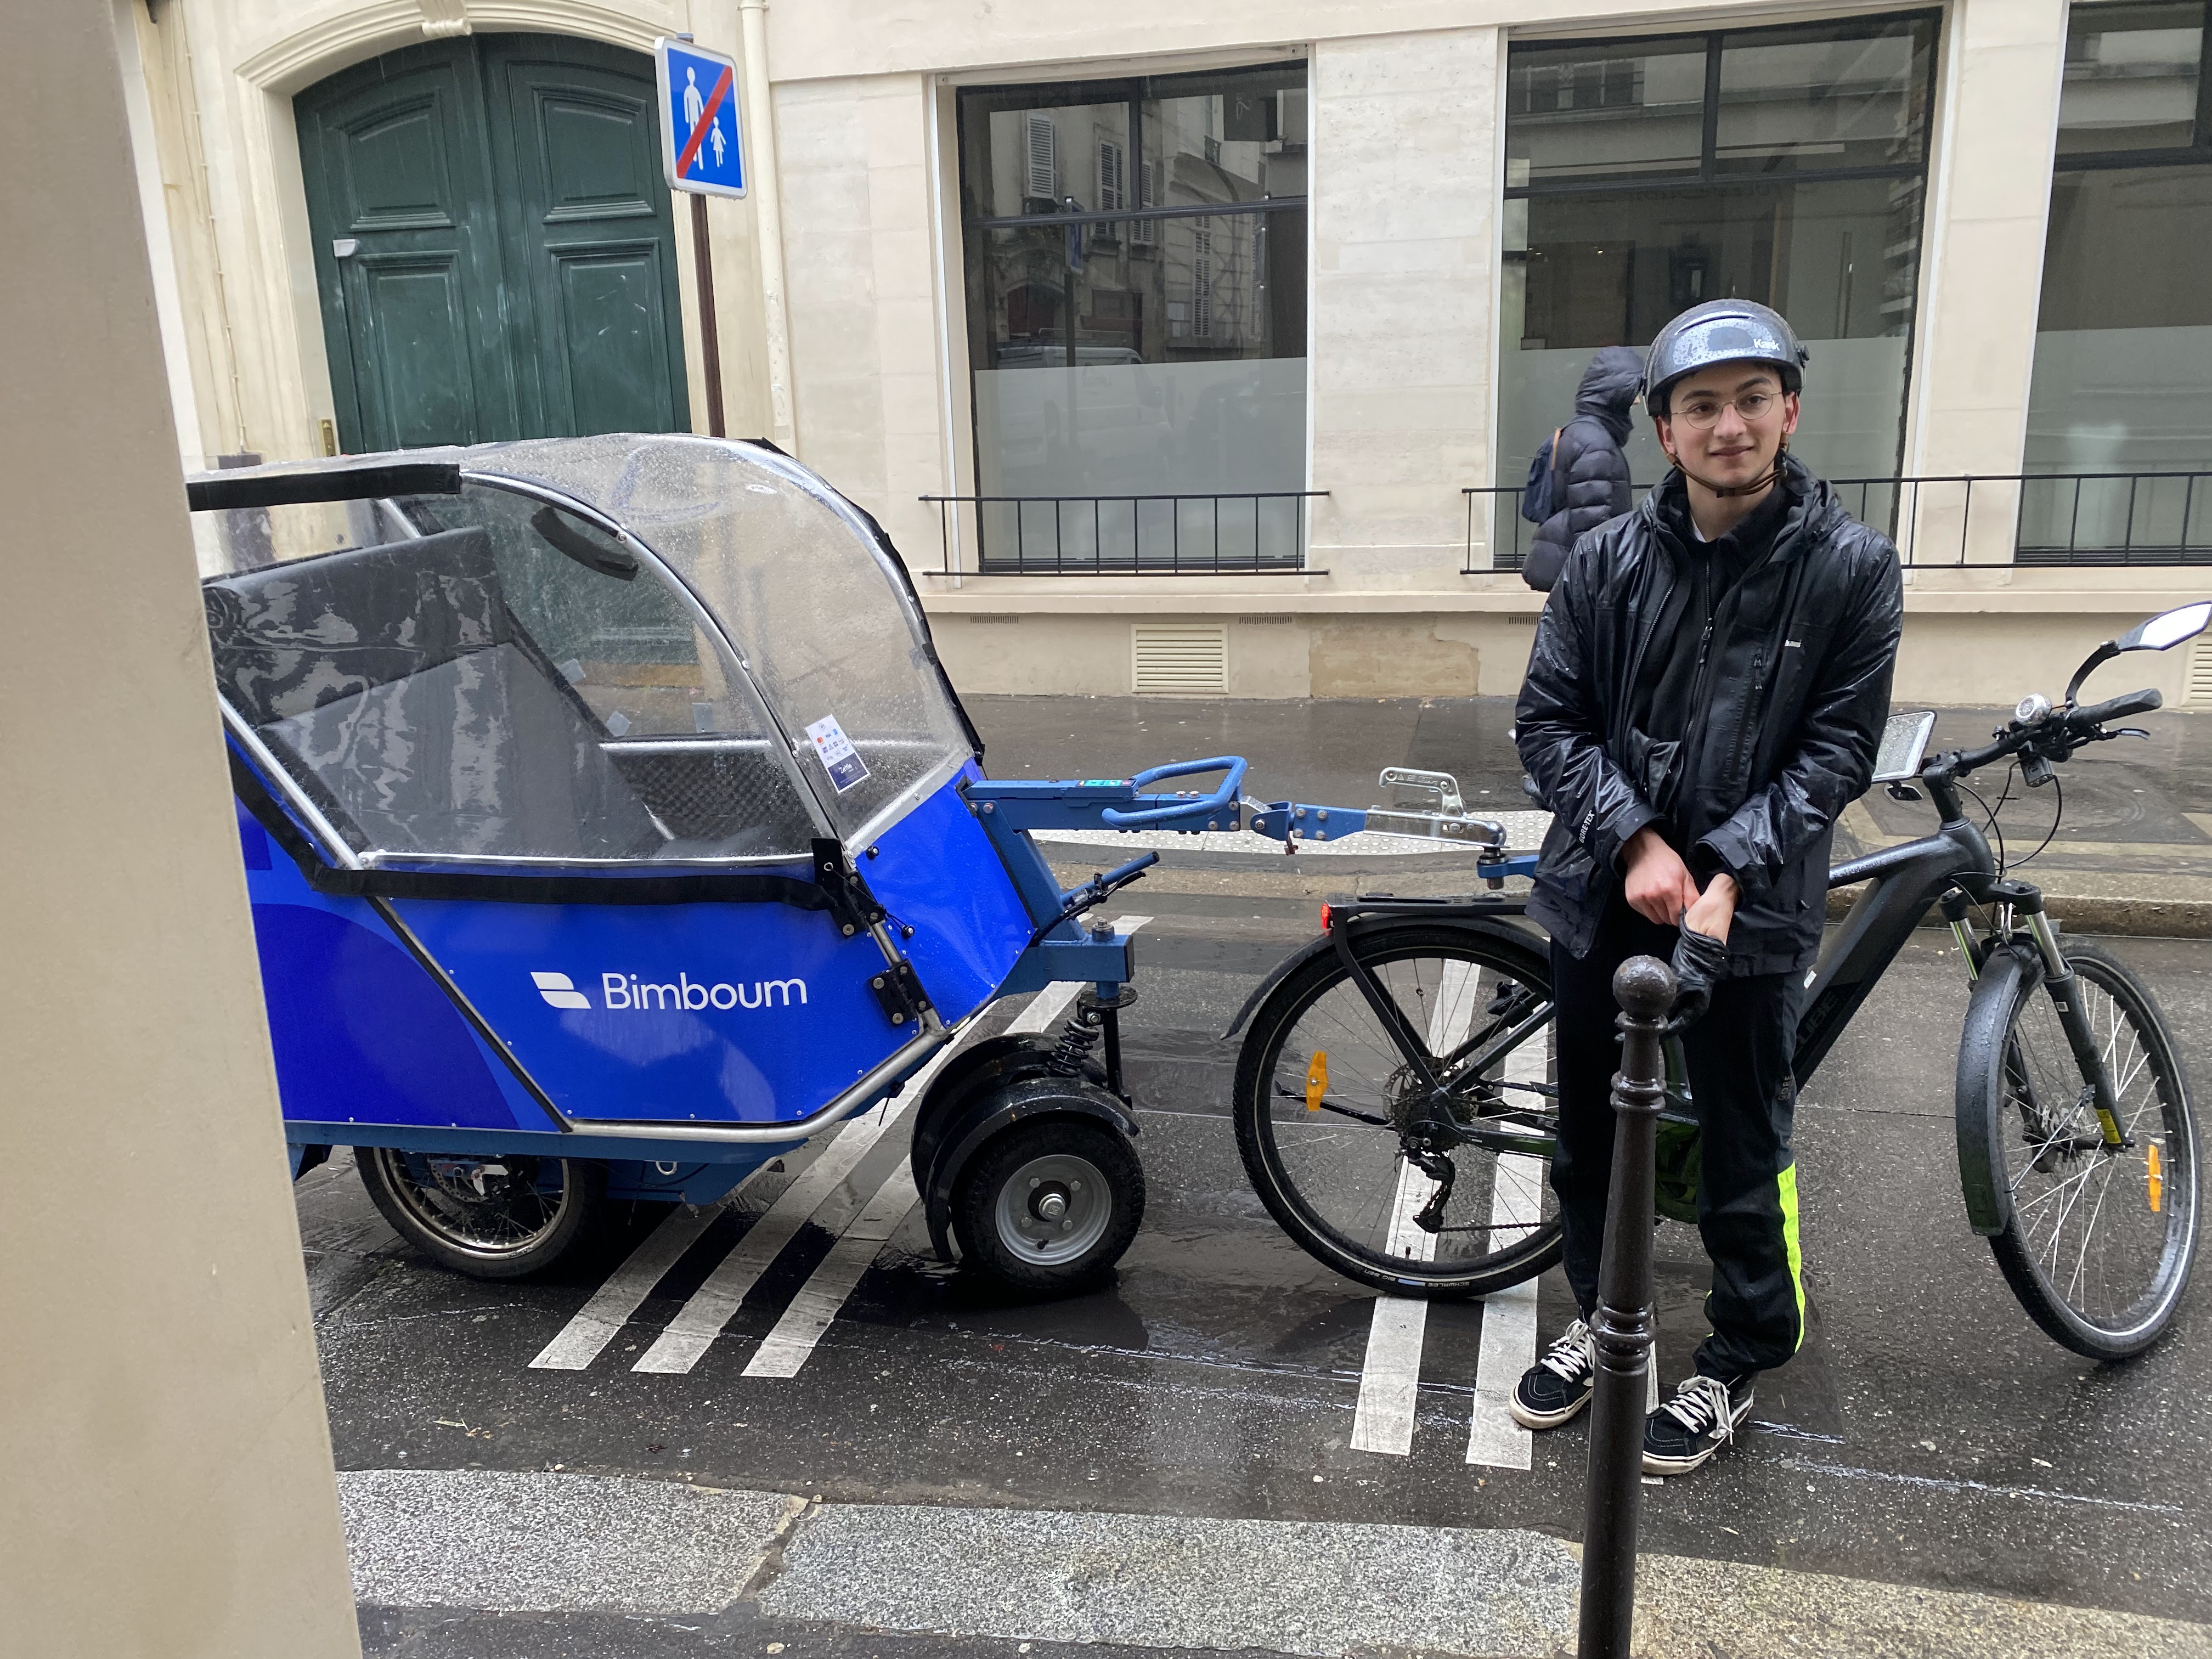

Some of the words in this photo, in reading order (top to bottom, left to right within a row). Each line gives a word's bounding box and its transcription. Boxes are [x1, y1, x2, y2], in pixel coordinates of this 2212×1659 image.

[1753, 338, 1780, 351] Kask
[602, 972, 808, 1011] Bimboum
[1792, 991, 1839, 1057] UBE
[1777, 1075, 1792, 1101] GORE
